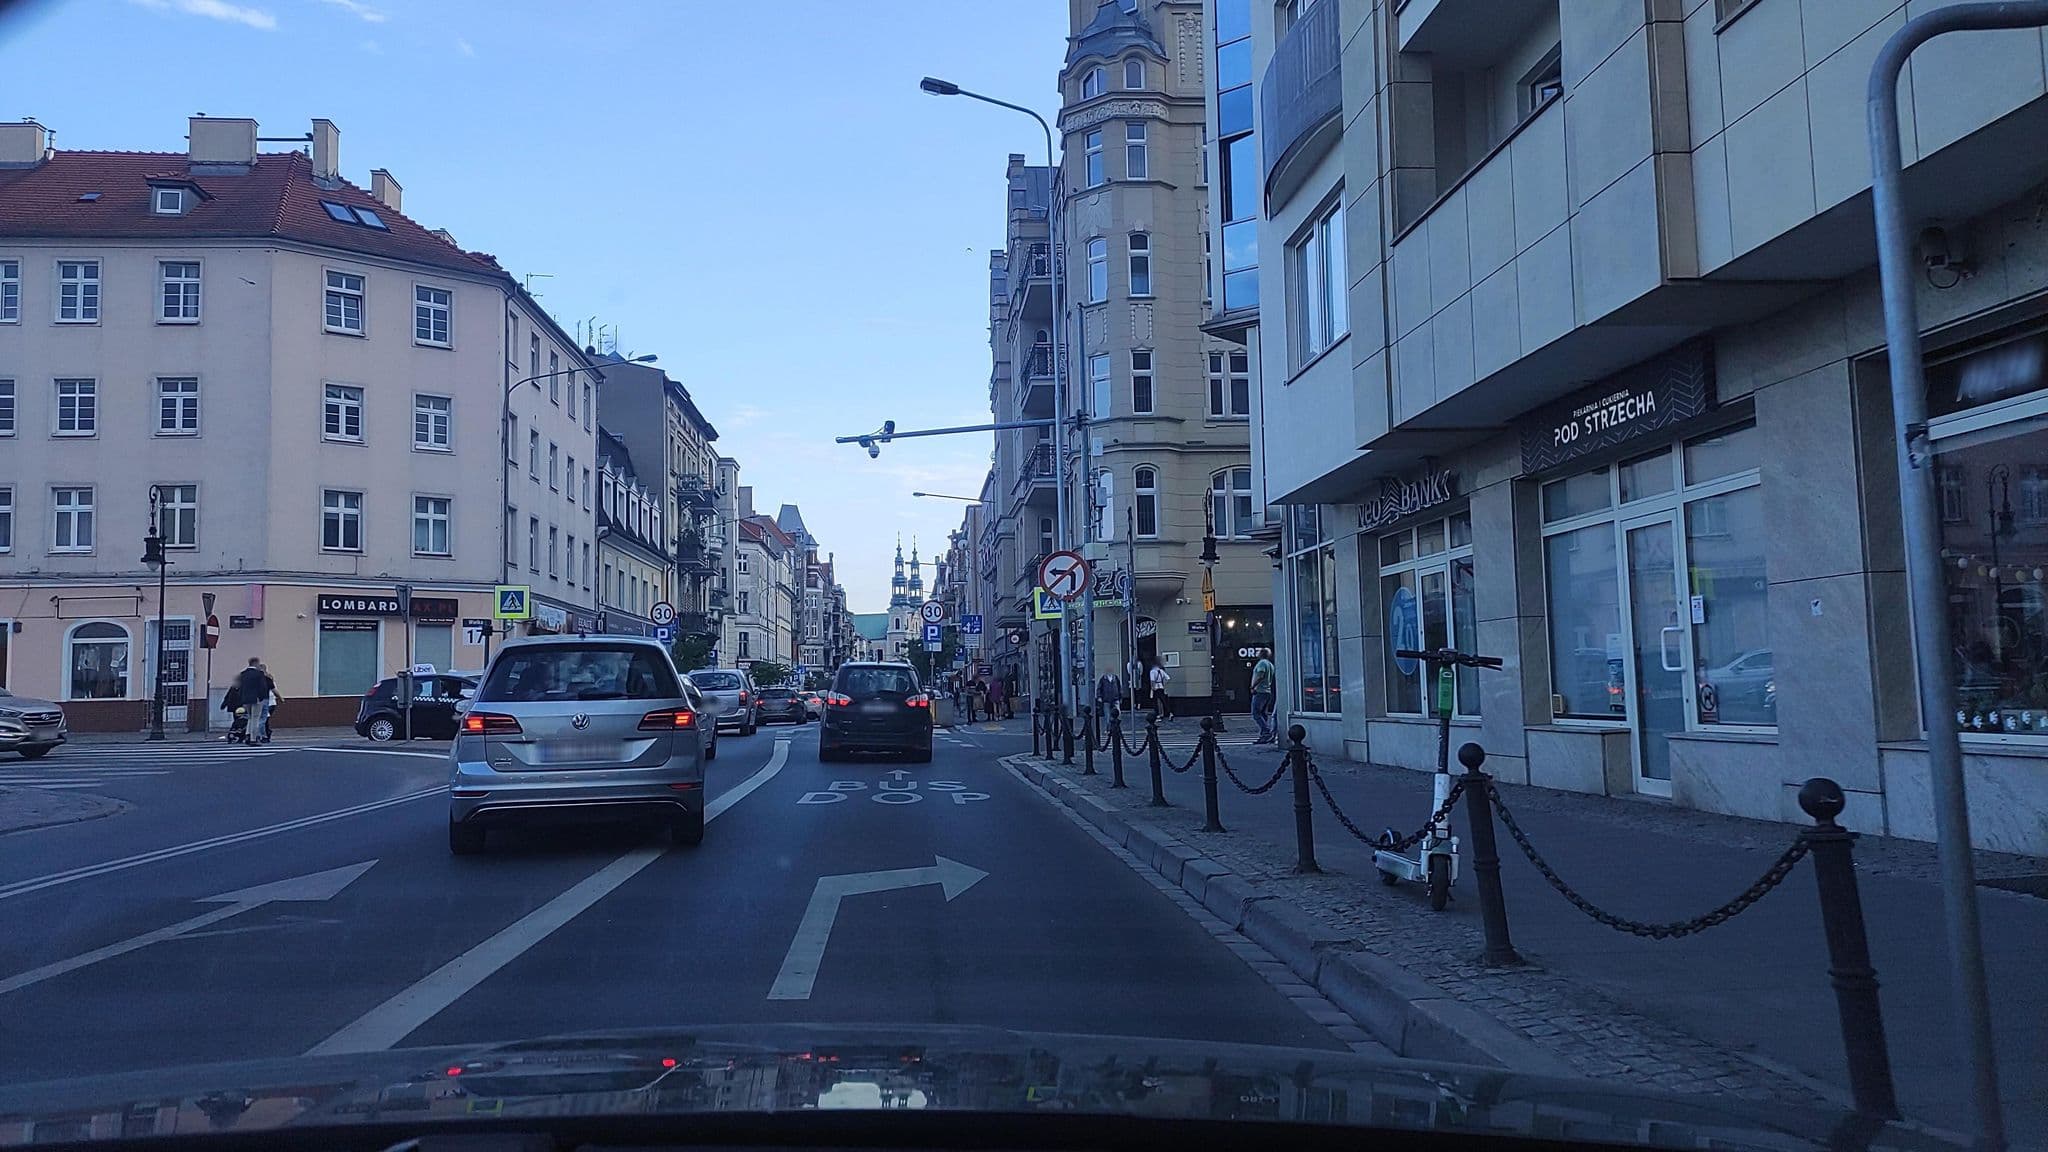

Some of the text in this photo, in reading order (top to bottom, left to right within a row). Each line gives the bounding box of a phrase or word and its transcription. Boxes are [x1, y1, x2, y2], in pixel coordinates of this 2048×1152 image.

[1573, 404, 1598, 418] PIEKARNIA
[1602, 389, 1630, 407] CUKIERNIA
[1554, 390, 1656, 447] POD STRZECHA
[321, 598, 399, 612] LOMBARD
[924, 605, 942, 618] 30
[654, 608, 672, 619] 30
[467, 628, 483, 644] 17
[657, 628, 669, 640] P
[927, 625, 938, 641] P
[413, 665, 432, 674] Uber
[828, 780, 967, 791] BUS
[796, 792, 990, 805] DOP
